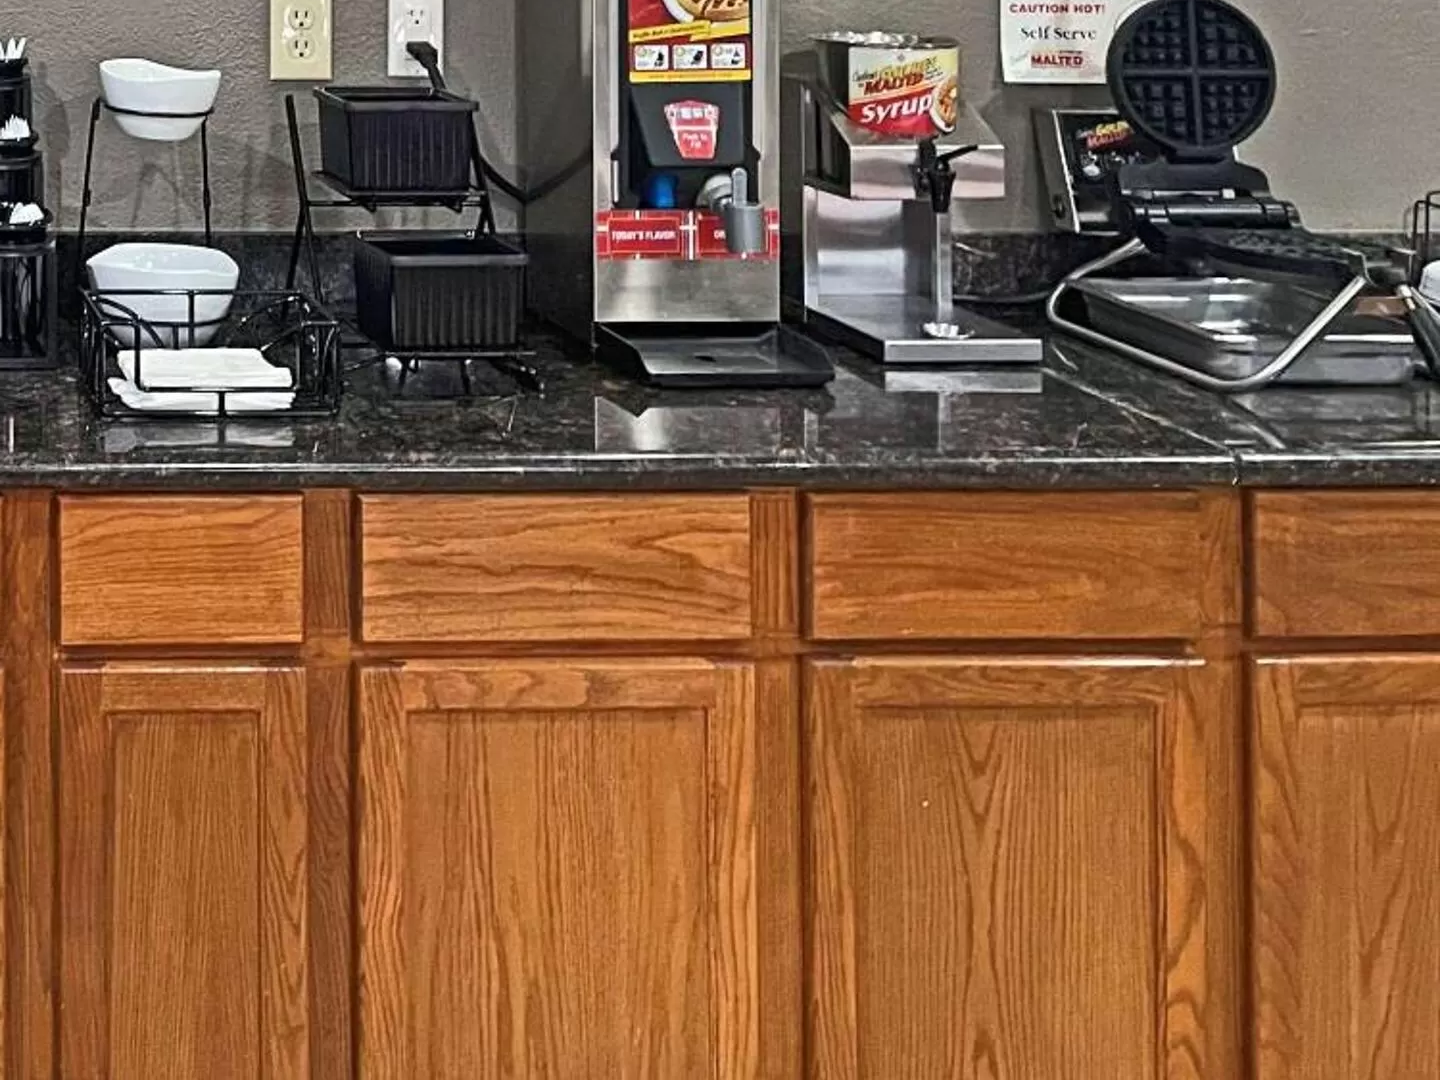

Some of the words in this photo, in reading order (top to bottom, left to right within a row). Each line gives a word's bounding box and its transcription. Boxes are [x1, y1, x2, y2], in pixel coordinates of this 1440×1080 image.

[1009, 3, 1069, 14] CAUTION
[1074, 4, 1105, 14] HOT!
[1021, 25, 1049, 40] Self
[1054, 26, 1097, 40] Serve
[1031, 54, 1084, 67] MALTED
[860, 94, 932, 125] Syrup
